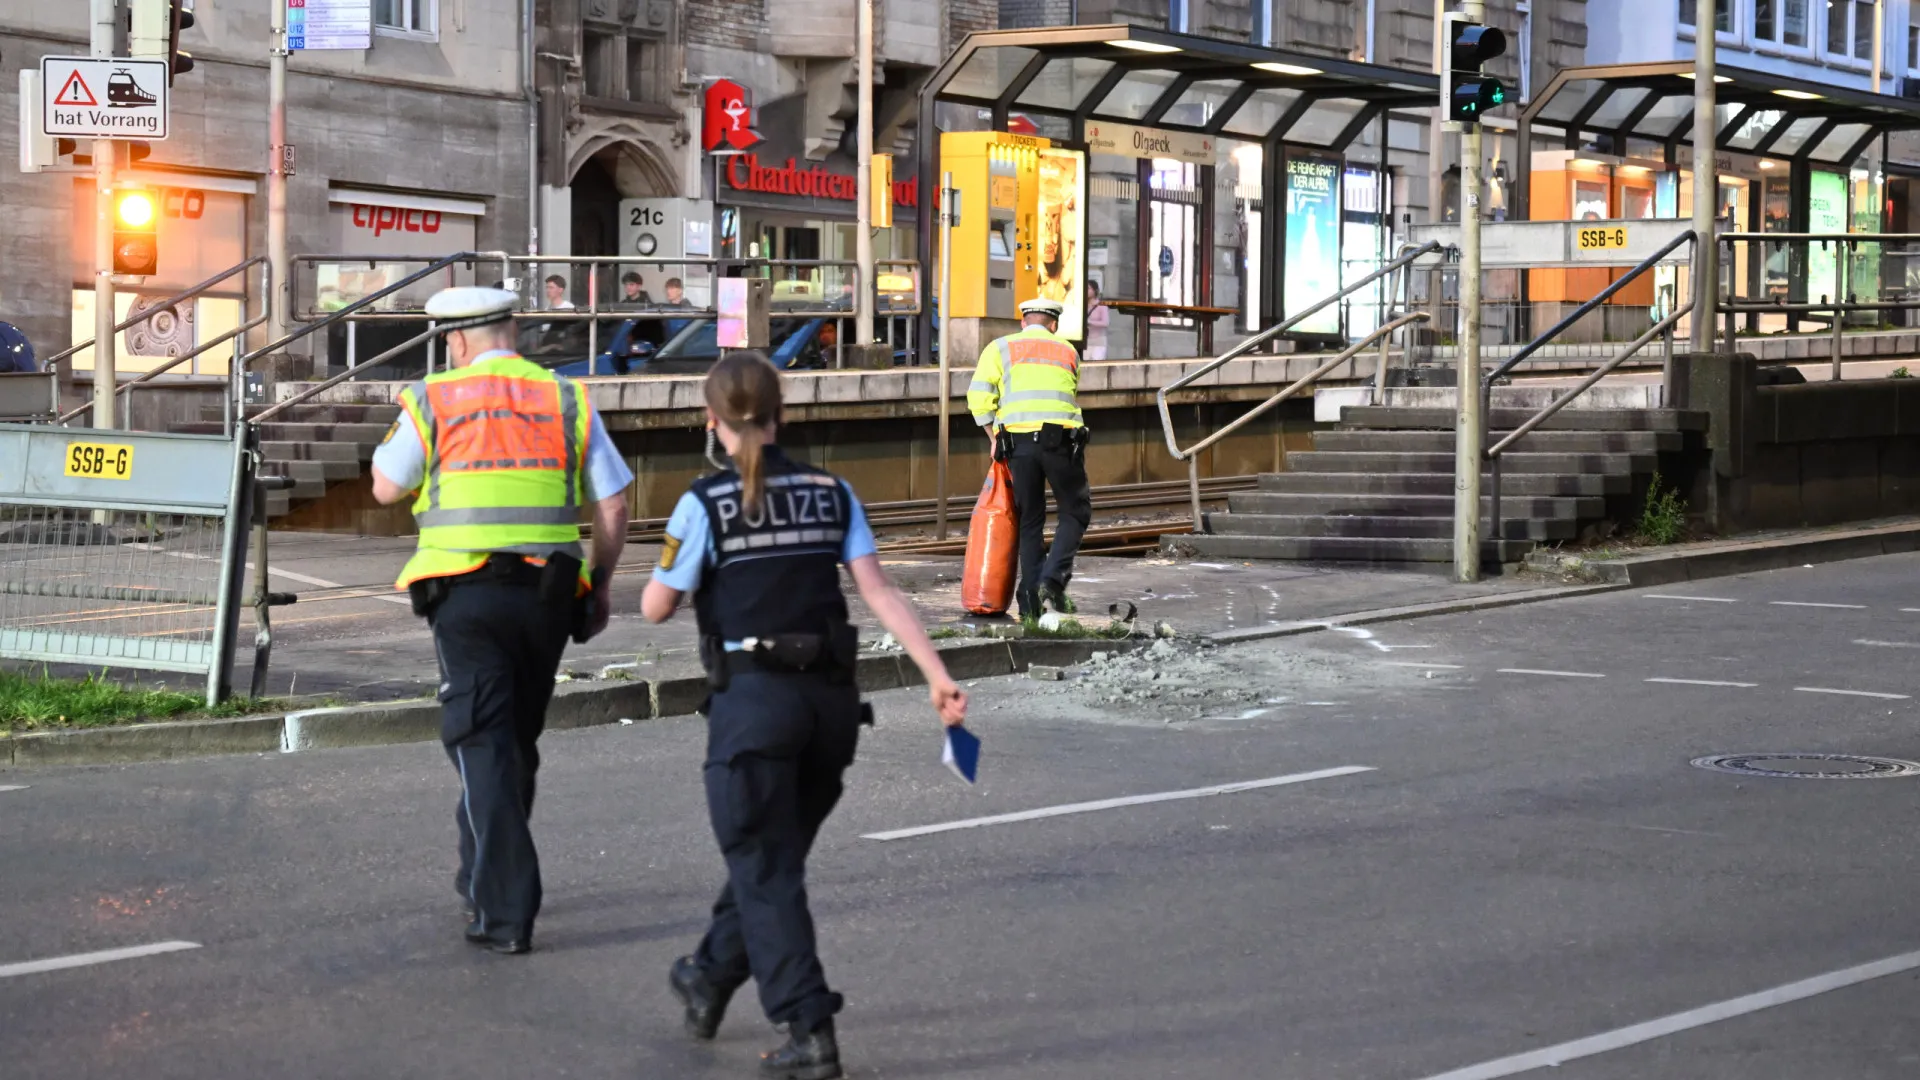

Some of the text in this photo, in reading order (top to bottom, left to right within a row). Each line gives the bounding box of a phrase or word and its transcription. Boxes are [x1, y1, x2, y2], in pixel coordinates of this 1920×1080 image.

[289, 38, 304, 48] U15
[54, 109, 158, 132] hat Vorrang
[1133, 130, 1170, 154] Olgaeck
[1316, 164, 1336, 177] KRAFT
[1294, 174, 1308, 188] DER
[630, 207, 664, 226] 21c
[1581, 229, 1624, 248] SSB-G
[71, 445, 128, 476] SSB-G
[716, 489, 843, 534] POLIZEI
